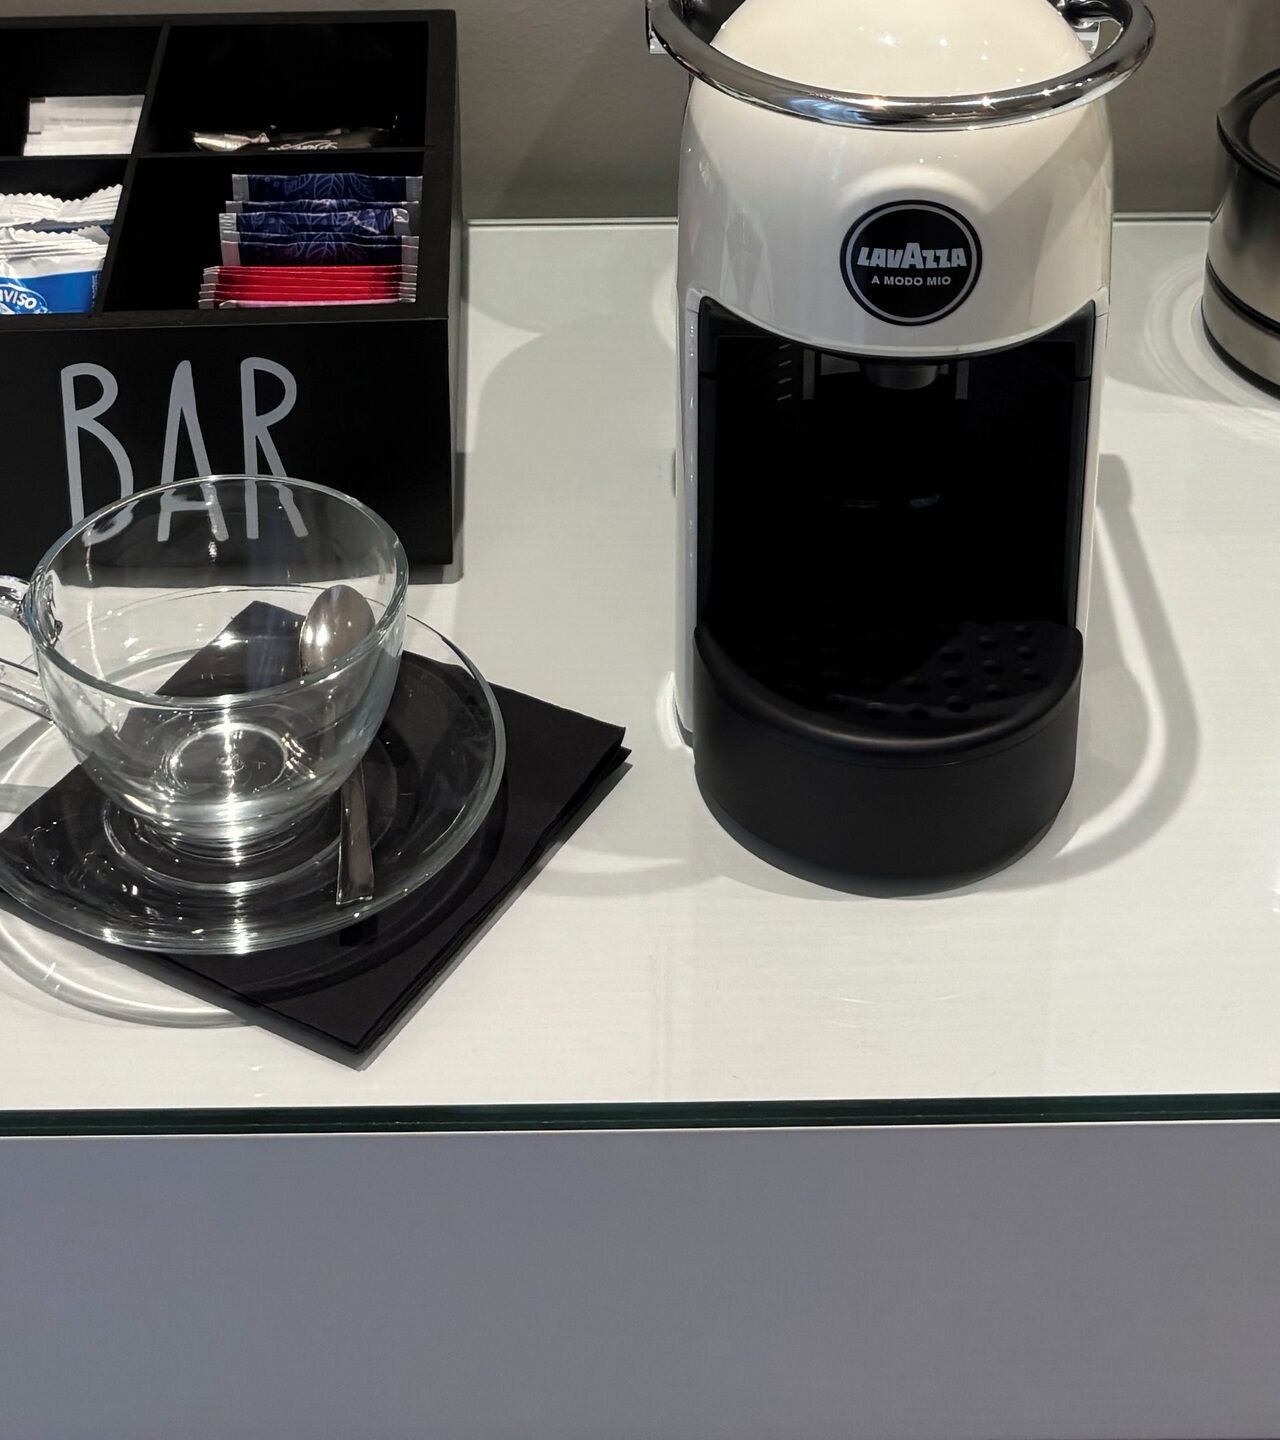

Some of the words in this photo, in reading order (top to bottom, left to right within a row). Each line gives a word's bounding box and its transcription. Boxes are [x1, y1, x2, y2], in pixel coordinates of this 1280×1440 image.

[856, 242, 968, 269] LAVAZZA
[871, 275, 881, 285] A
[883, 275, 923, 286] MODO
[926, 275, 952, 286] MIO
[60, 357, 310, 546] BAR
